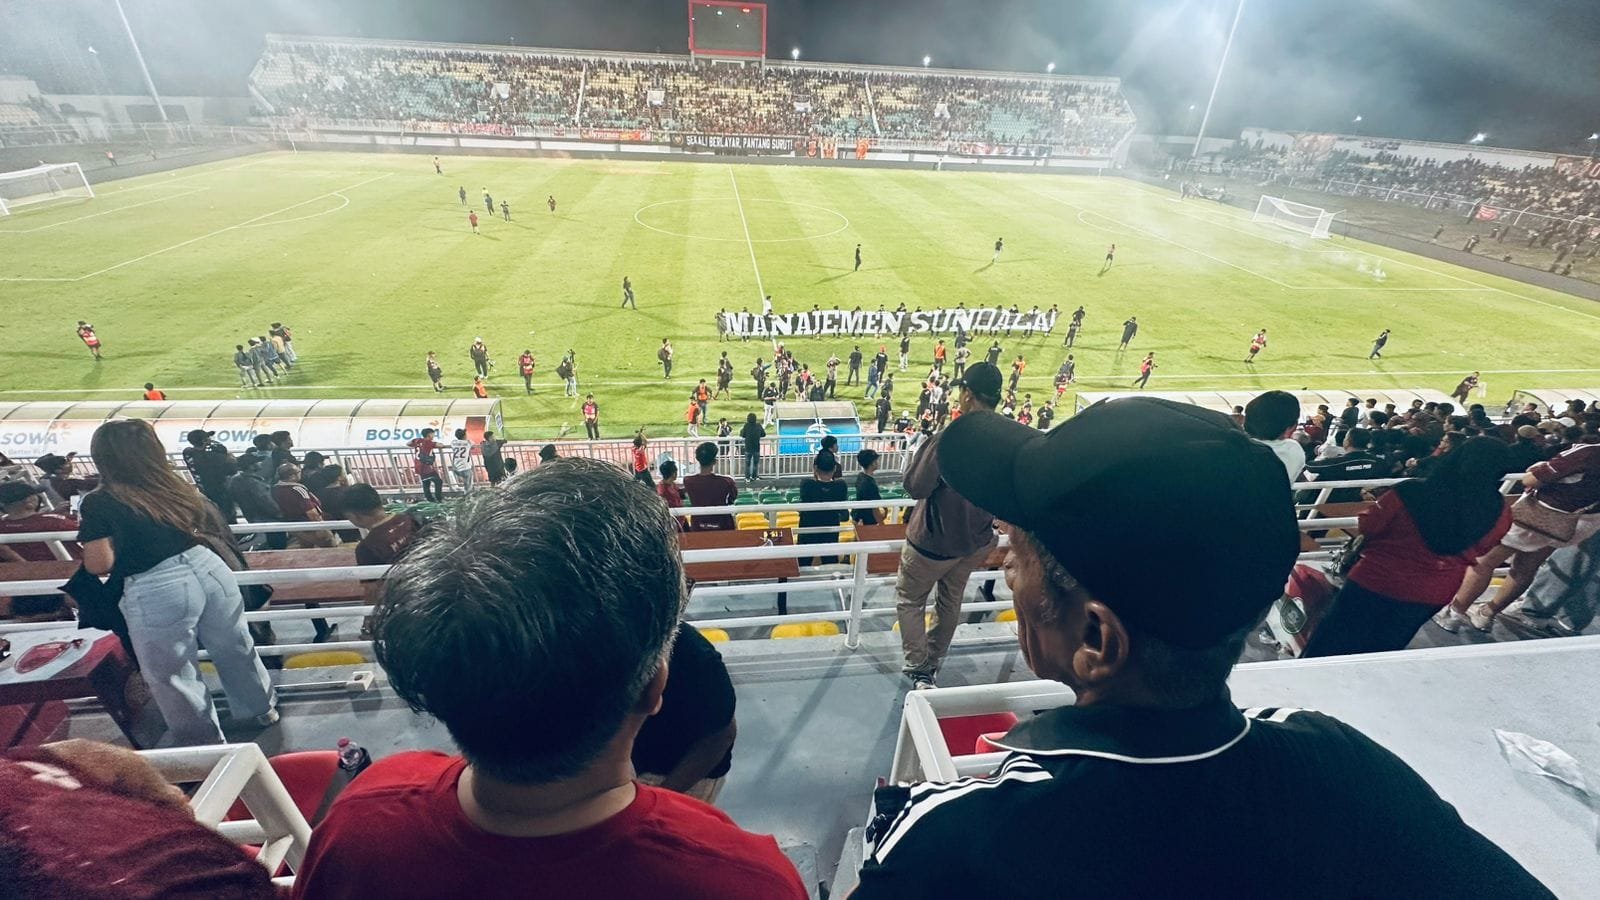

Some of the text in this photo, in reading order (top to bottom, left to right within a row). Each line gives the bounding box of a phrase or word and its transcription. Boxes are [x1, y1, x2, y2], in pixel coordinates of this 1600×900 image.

[686, 135, 708, 147] SEKALI
[742, 138, 771, 149] PANTANG
[726, 310, 905, 336] MANAJEMEN
[453, 447, 466, 459] 22
